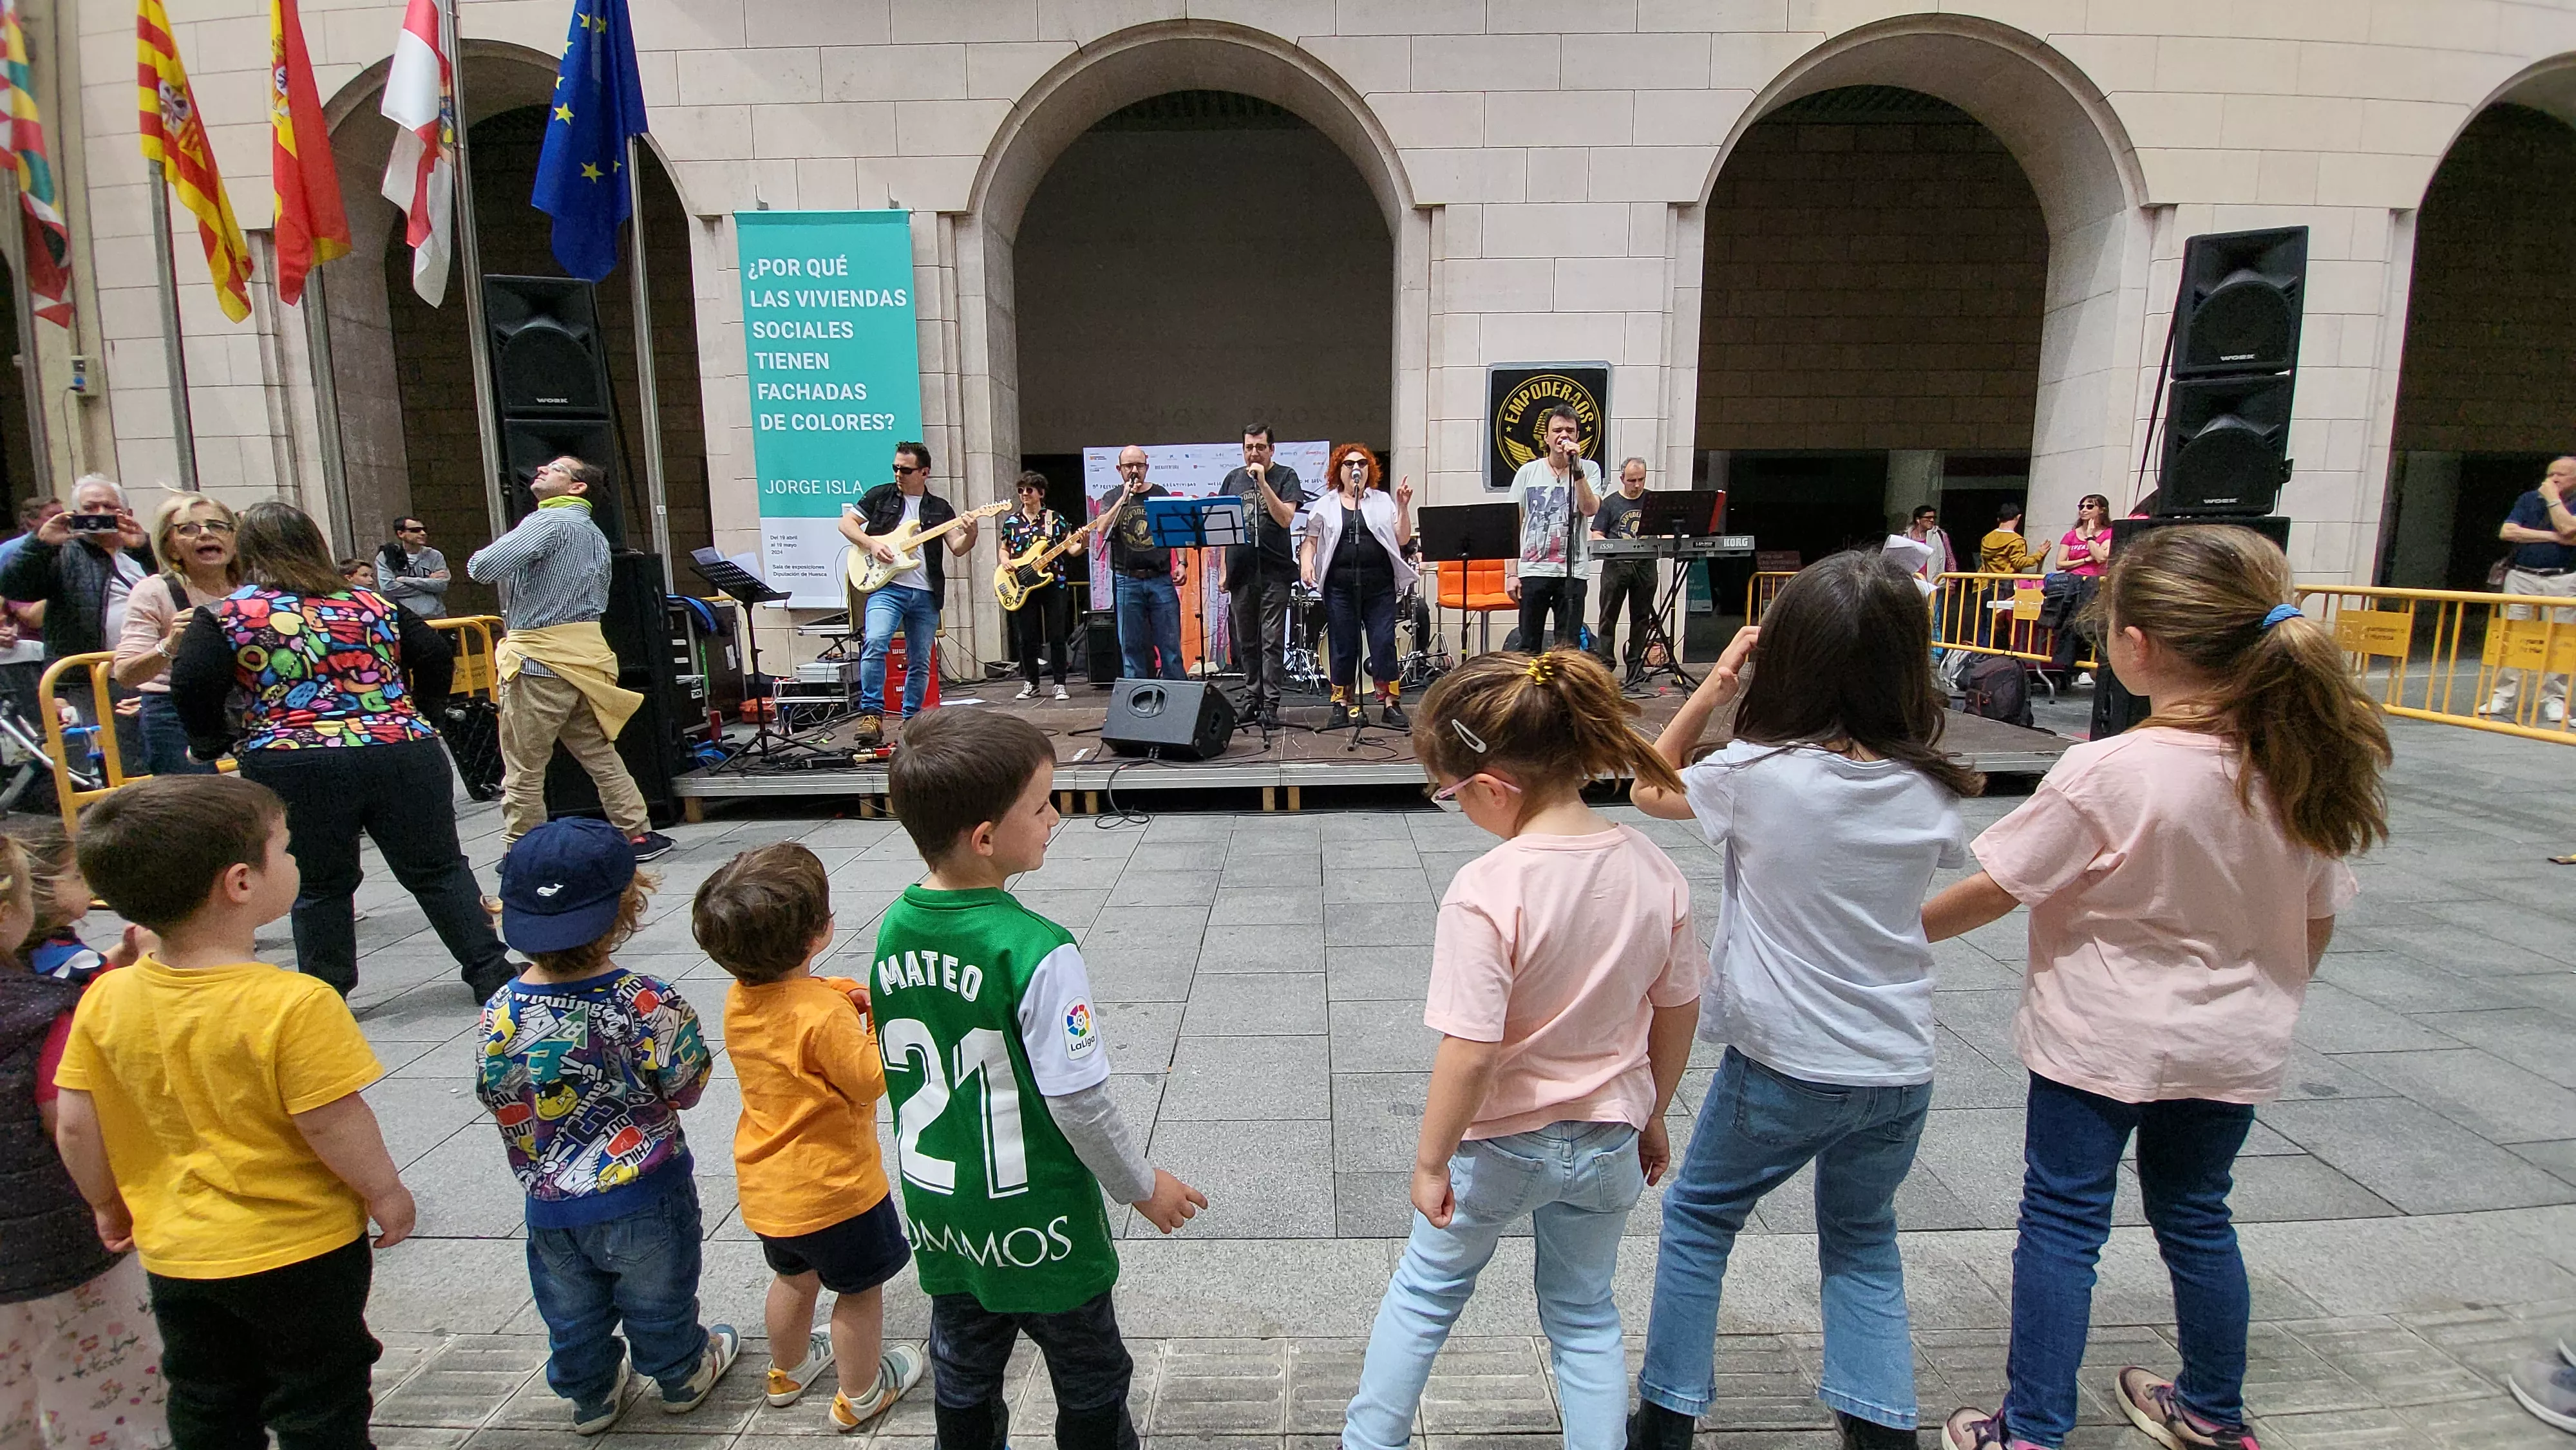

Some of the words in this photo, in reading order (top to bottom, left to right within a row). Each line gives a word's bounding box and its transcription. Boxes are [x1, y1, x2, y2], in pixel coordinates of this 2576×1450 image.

[748, 258, 800, 279] ¿POR
[807, 254, 848, 278] QUÉ
[750, 290, 789, 308] LAS
[795, 288, 907, 307] VIVIENDAS
[753, 321, 853, 339] SOCIALES
[755, 352, 829, 370] TIENEN
[758, 383, 867, 400] FACHADAS
[1504, 381, 1594, 424] EMPODERAOS
[761, 414, 785, 431] DE
[791, 413, 895, 431] COLORES?
[766, 480, 820, 494] JORGE
[827, 479, 864, 494] ISLA
[1723, 538, 1748, 547] KORG
[878, 950, 983, 1002] MATEO
[515, 992, 605, 1017] winning
[1070, 1035, 1095, 1051] LaLiga
[879, 1017, 1029, 1200] 21
